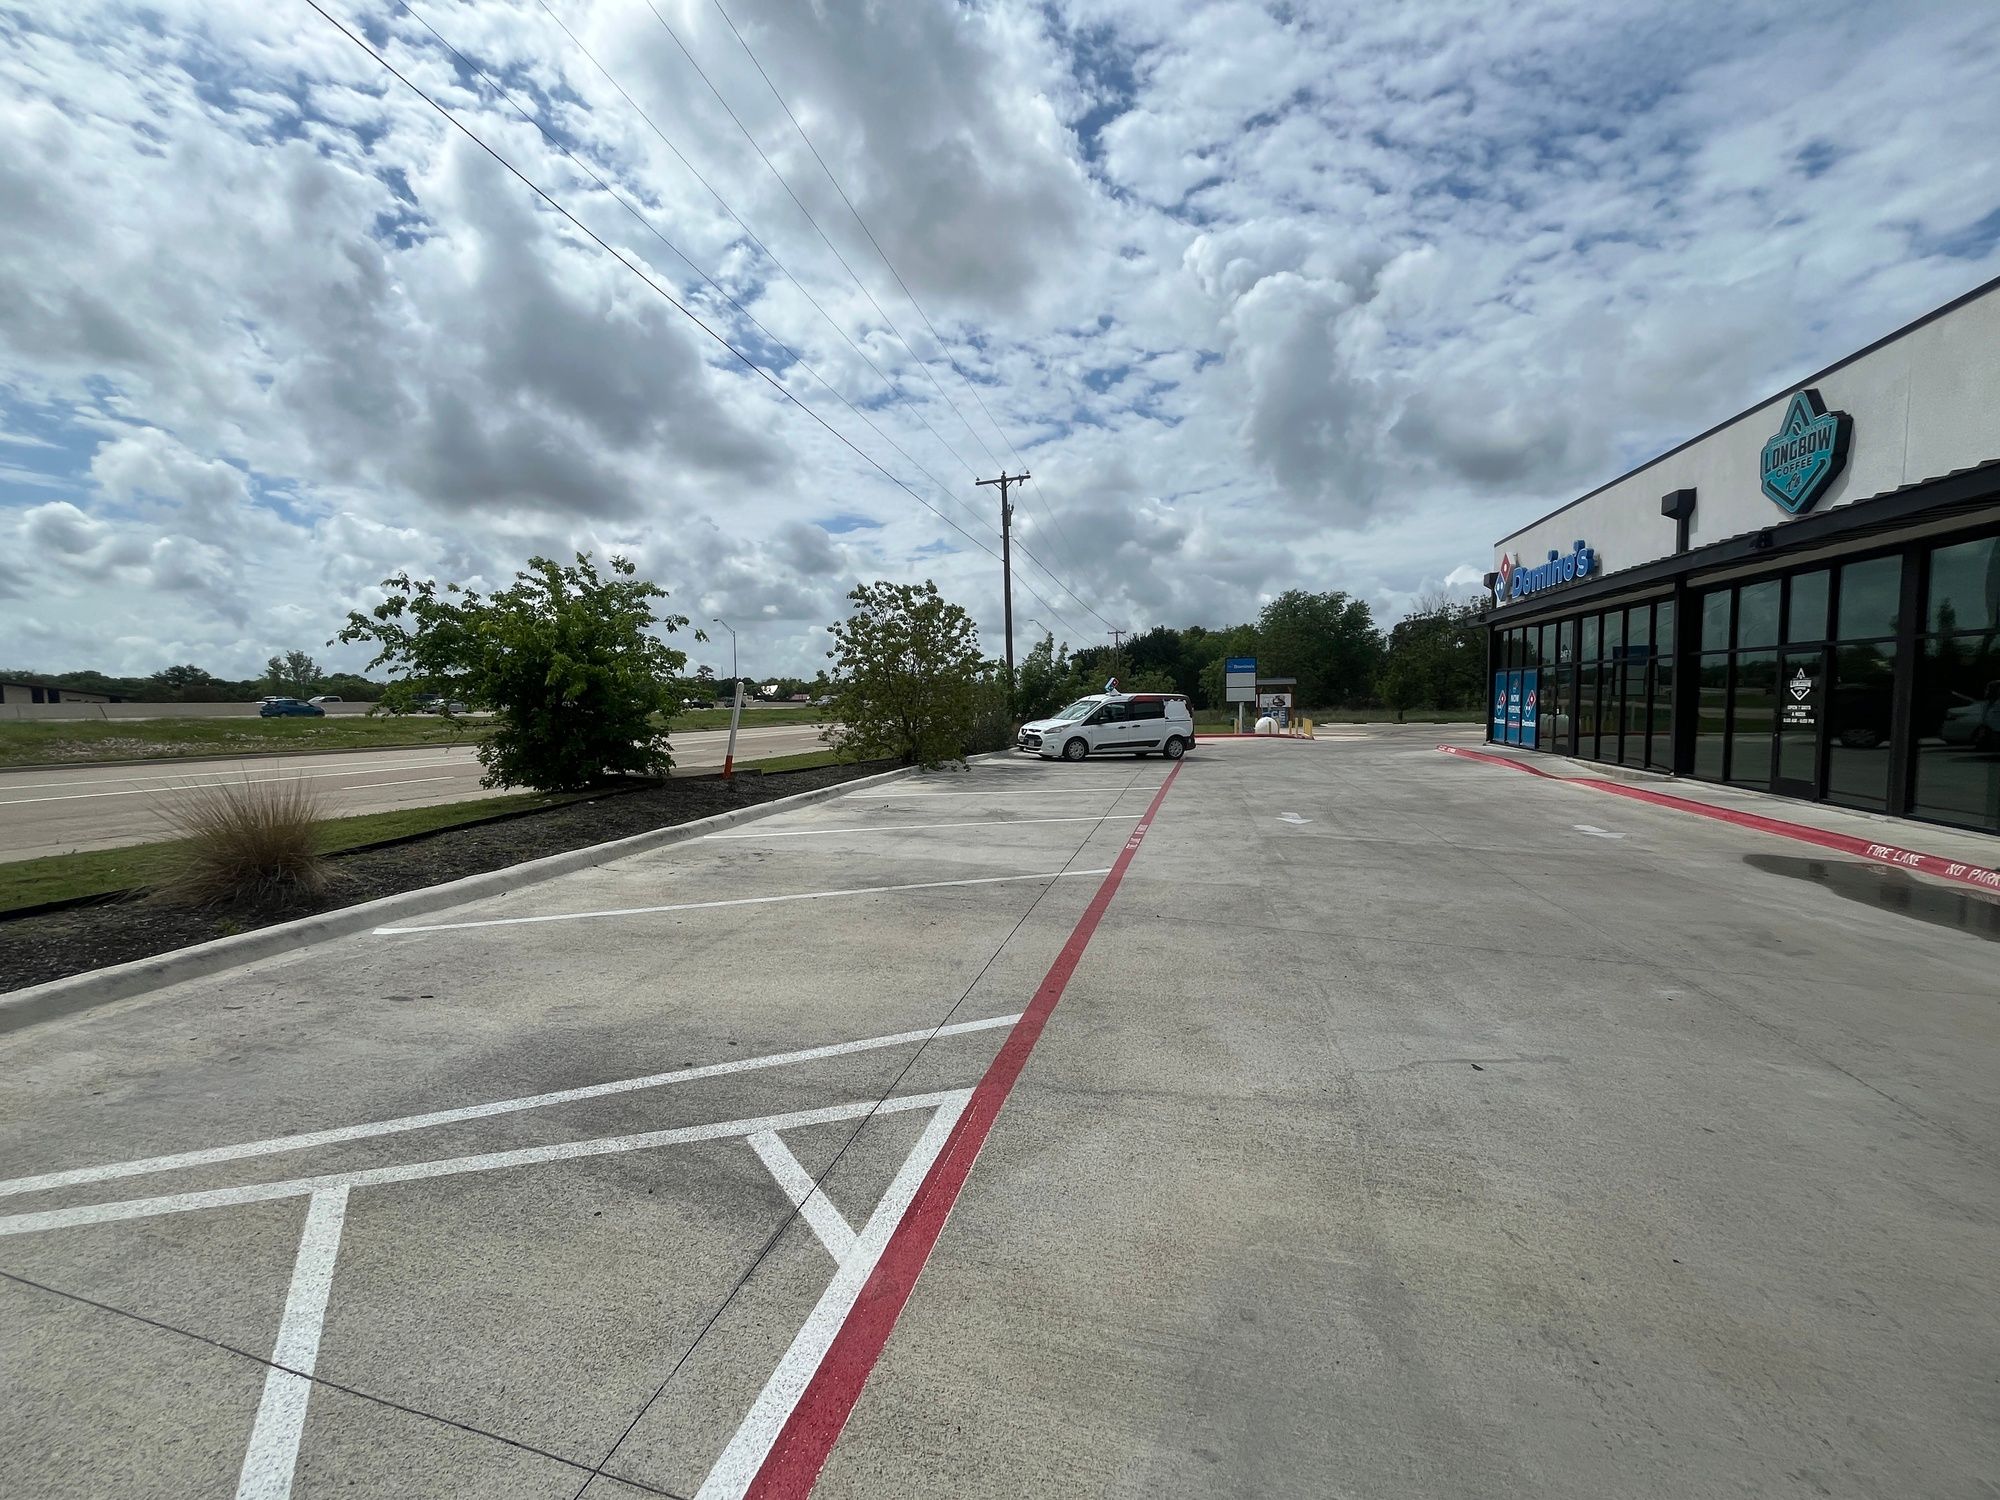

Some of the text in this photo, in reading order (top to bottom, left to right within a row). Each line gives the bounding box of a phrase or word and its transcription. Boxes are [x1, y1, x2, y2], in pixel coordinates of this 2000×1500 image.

[1765, 425, 1833, 474] LONGBOW
[1776, 457, 1812, 478] COFFEE
[1512, 540, 1594, 599] Domino's
[1866, 844, 1926, 866] FIRE LANE
[1945, 863, 1967, 876] NO
